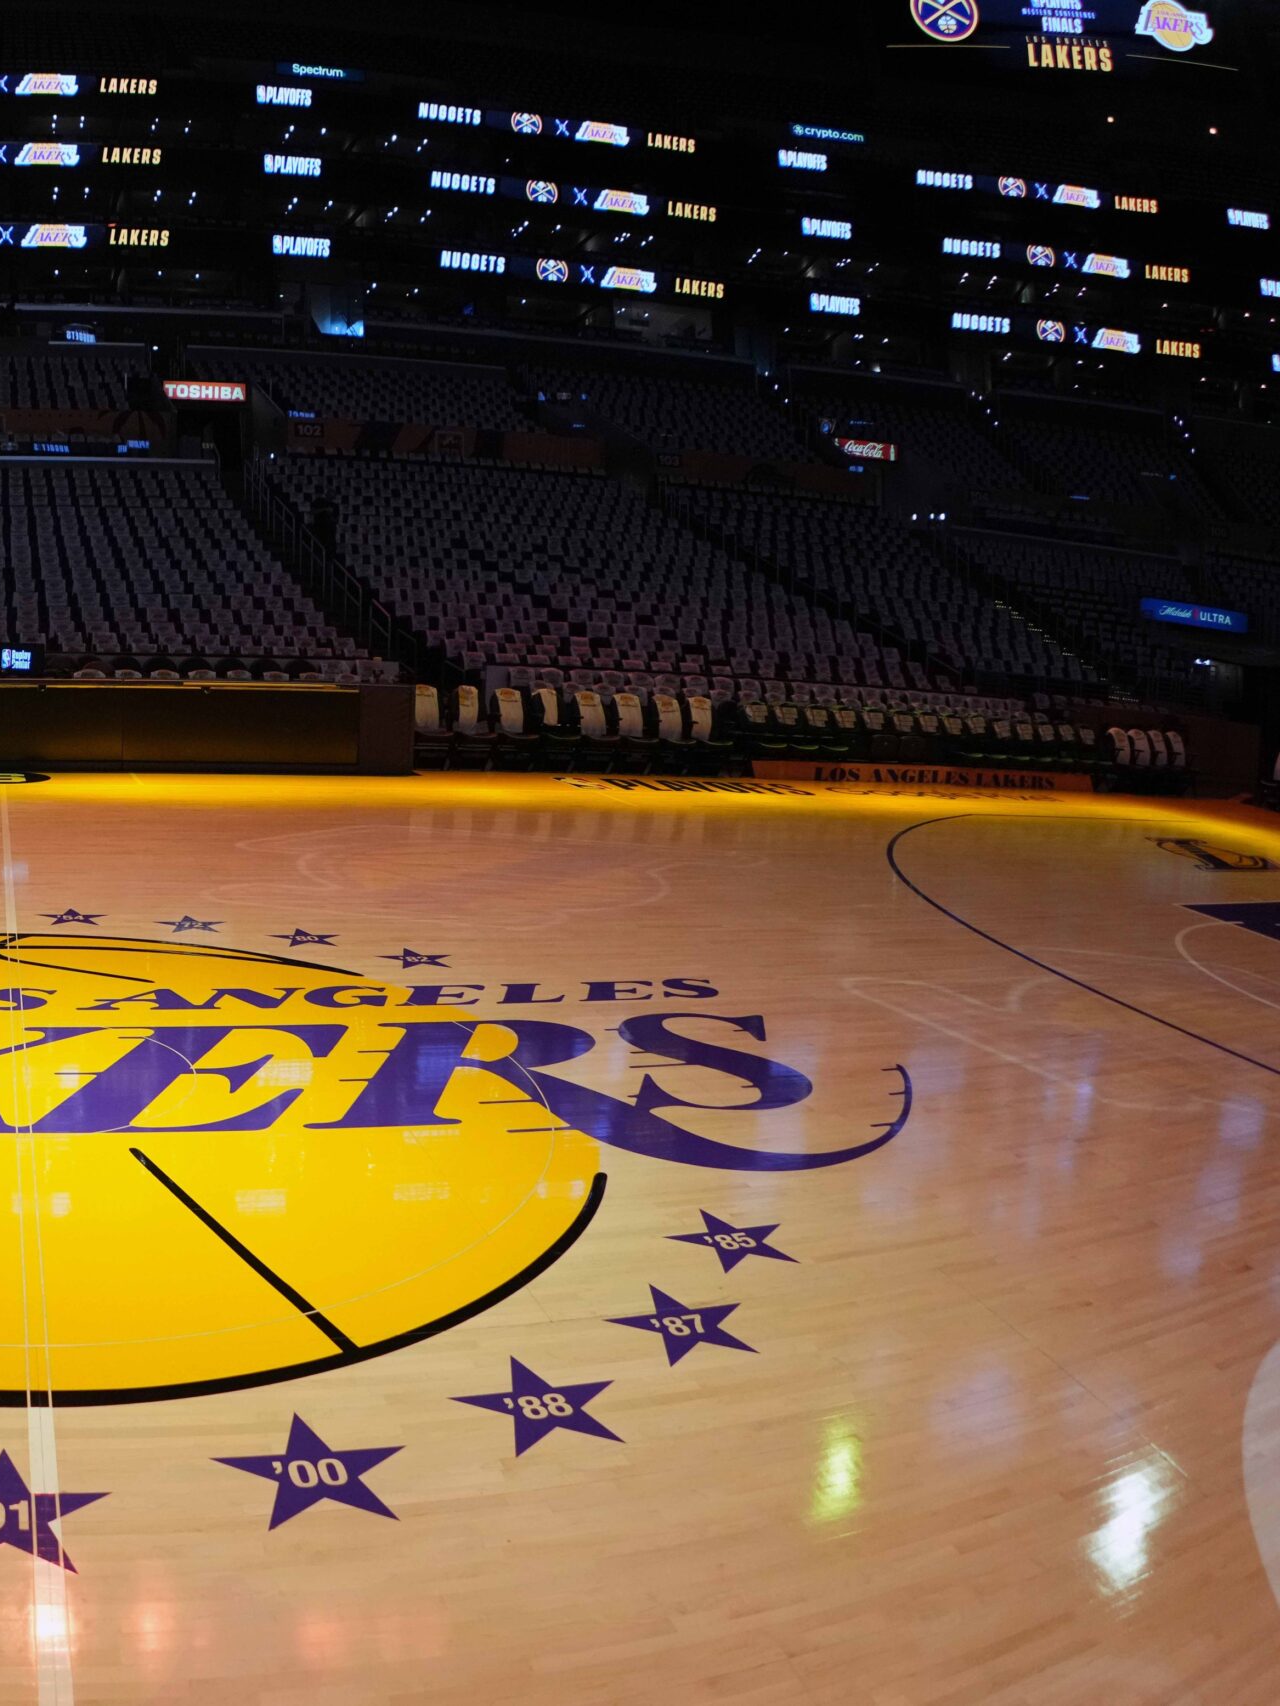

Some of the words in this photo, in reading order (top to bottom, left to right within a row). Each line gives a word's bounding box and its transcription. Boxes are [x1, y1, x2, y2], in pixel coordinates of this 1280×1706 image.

[1042, 17, 1082, 33] FINALS
[1027, 43, 1113, 72] LAKERS
[292, 63, 345, 78] Spectrum
[100, 78, 157, 94] LAKERS
[265, 86, 312, 107] PLAYOFFS
[418, 102, 481, 125] NUGGETS
[648, 133, 695, 153] LAKERS
[805, 124, 865, 142] crypto.com
[102, 147, 161, 164] LAKERS
[274, 155, 321, 177] PLAYOFFS
[787, 152, 827, 171] PLAYOFFS
[431, 171, 495, 194] NUGGETS
[668, 201, 716, 221] LAKERS
[916, 170, 973, 190] NUGGETS
[1115, 196, 1157, 213] LAKERS
[110, 229, 169, 246] LAKERS
[811, 219, 851, 240] PLAYOFFS
[283, 236, 330, 258] PLAYOFFS
[943, 238, 1000, 258] NUGGETS
[1146, 265, 1188, 282] LAKERS
[440, 250, 505, 273] NUGGETS
[676, 278, 724, 298] LAKERS
[819, 295, 860, 315] PLAYOFFS
[952, 313, 1010, 333] NUGGETS
[1157, 340, 1200, 358] LAKERS
[165, 384, 243, 400] TOSHIBA
[844, 440, 884, 458] Coca-Cola
[1200, 611, 1231, 625] ULTRA
[601, 778, 816, 796] PLAYOFFS
[814, 767, 860, 782] LOS
[871, 767, 969, 786] ANGELES
[976, 772, 1057, 790] LAKERS
[76, 978, 720, 1012] ANGELES
[703, 1232, 757, 1250] '85
[649, 1314, 705, 1336] '87
[503, 1393, 574, 1420] '88
[271, 1458, 348, 1488] '00
